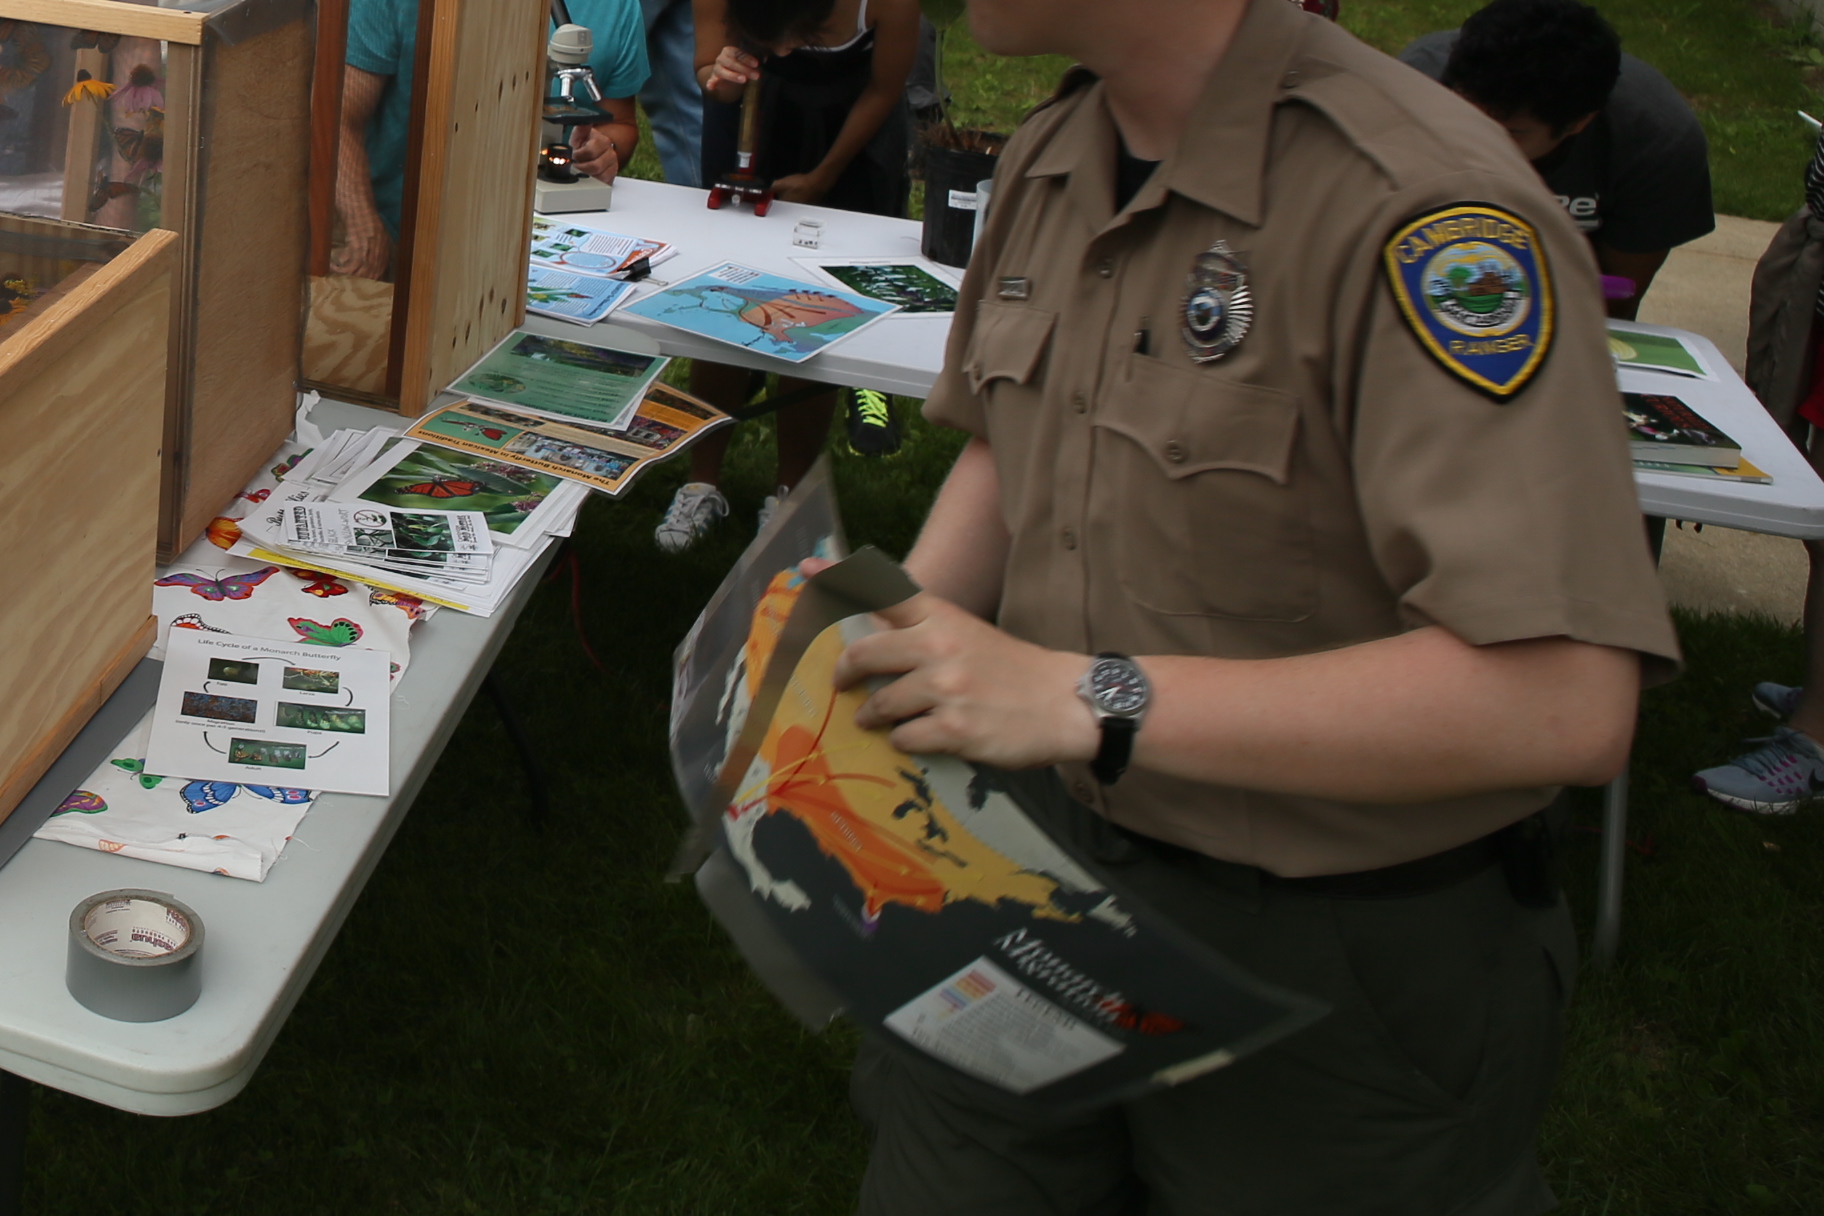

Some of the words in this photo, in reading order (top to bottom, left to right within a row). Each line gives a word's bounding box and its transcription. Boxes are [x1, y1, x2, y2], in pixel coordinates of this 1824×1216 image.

[1395, 217, 1530, 264] CAMBRIDGE
[1448, 334, 1536, 356] RANGER
[418, 429, 461, 446] Traditions
[462, 441, 499, 455] Mexican
[509, 453, 550, 469] Butterfly
[551, 464, 592, 480] Monarch
[593, 476, 610, 486] The
[197, 638, 215, 646] Life
[215, 640, 241, 649] Cycle
[260, 646, 301, 657] Monarch
[302, 651, 342, 662] Butterfly
[131, 933, 174, 951] ashua
